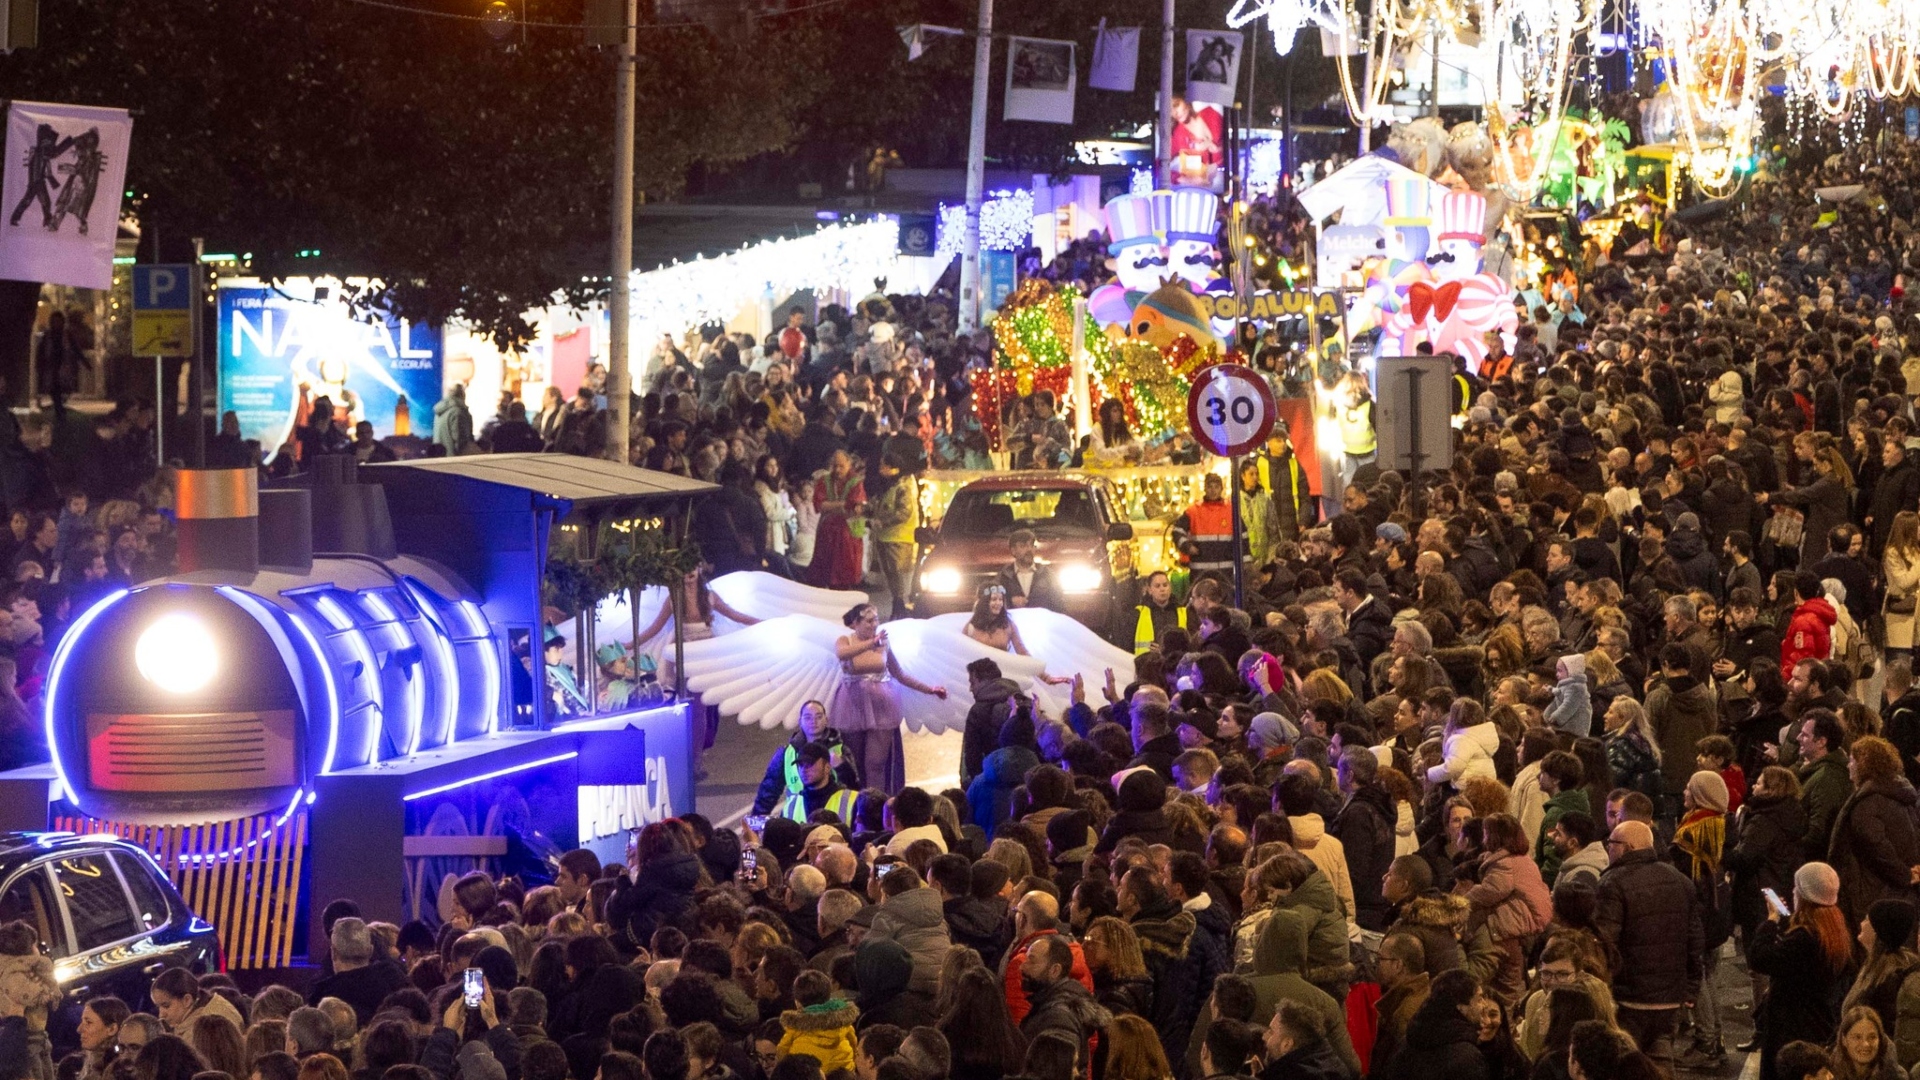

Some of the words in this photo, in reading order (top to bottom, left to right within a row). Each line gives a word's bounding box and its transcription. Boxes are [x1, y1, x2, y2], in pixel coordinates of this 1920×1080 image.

[149, 269, 176, 304] P
[232, 310, 433, 359] NAAL
[1206, 396, 1254, 425] 30
[578, 757, 672, 842] ABANCA
